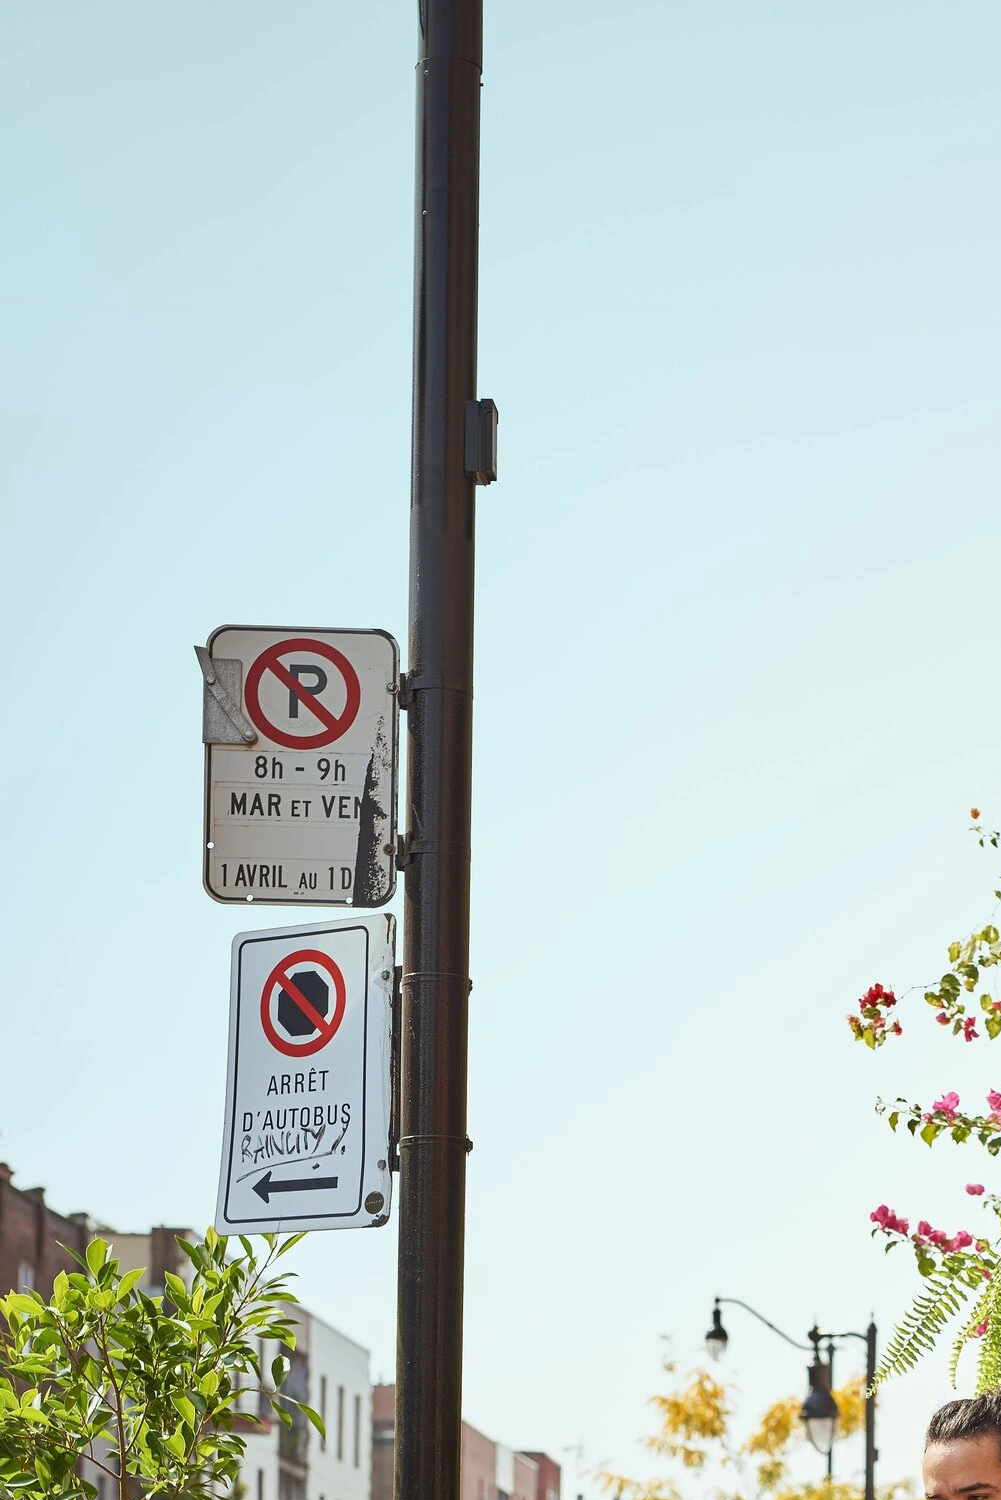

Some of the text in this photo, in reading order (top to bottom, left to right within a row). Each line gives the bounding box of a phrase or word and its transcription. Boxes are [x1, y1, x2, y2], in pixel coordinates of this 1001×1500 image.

[254, 755, 284, 779] 8h
[316, 757, 346, 782] 9h
[230, 792, 281, 817] MAR
[291, 800, 312, 818] ET
[234, 864, 288, 888] AVRIL
[298, 872, 318, 890] AU
[267, 1067, 329, 1096] ARRÊT
[243, 1103, 351, 1132] D'AUTOBUS
